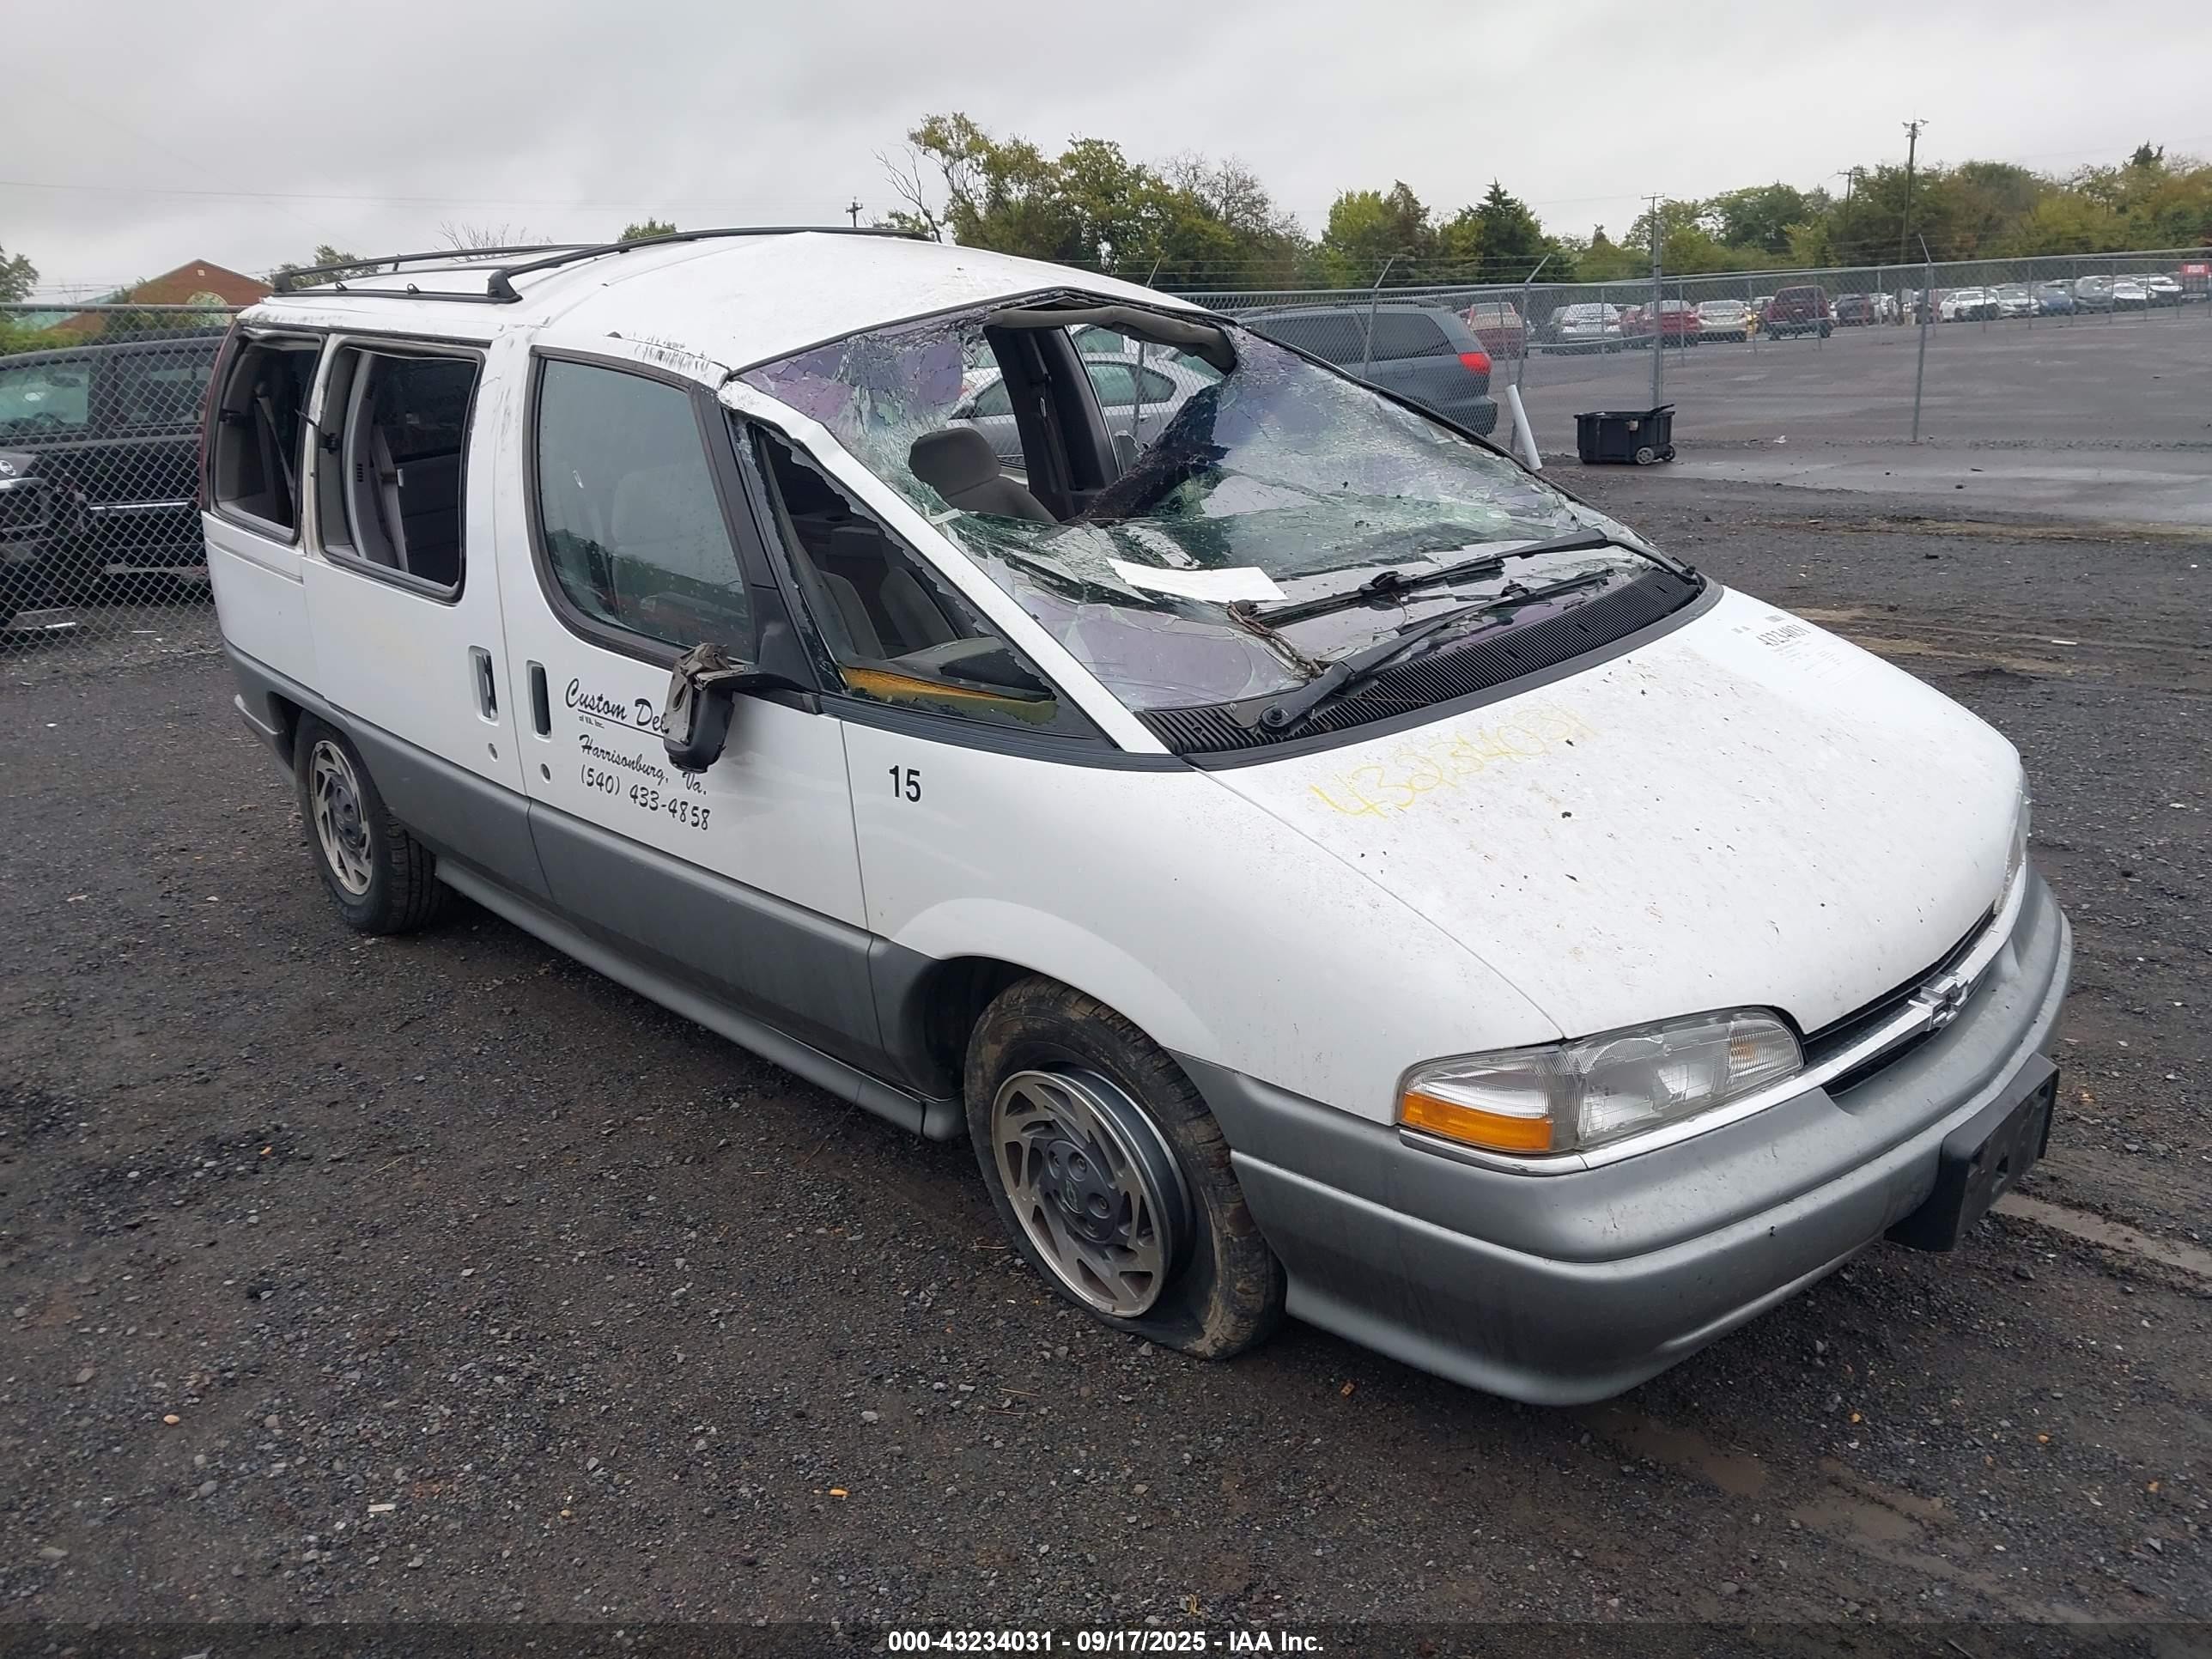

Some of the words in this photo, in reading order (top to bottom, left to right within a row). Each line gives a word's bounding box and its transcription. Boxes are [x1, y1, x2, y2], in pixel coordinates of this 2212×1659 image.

[565, 678, 628, 721] Custom
[579, 734, 670, 786] Harrisonburg,
[682, 771, 708, 795] Va.
[889, 764, 921, 803] 15
[580, 763, 621, 796] (540)
[629, 783, 711, 830] 433-4858
